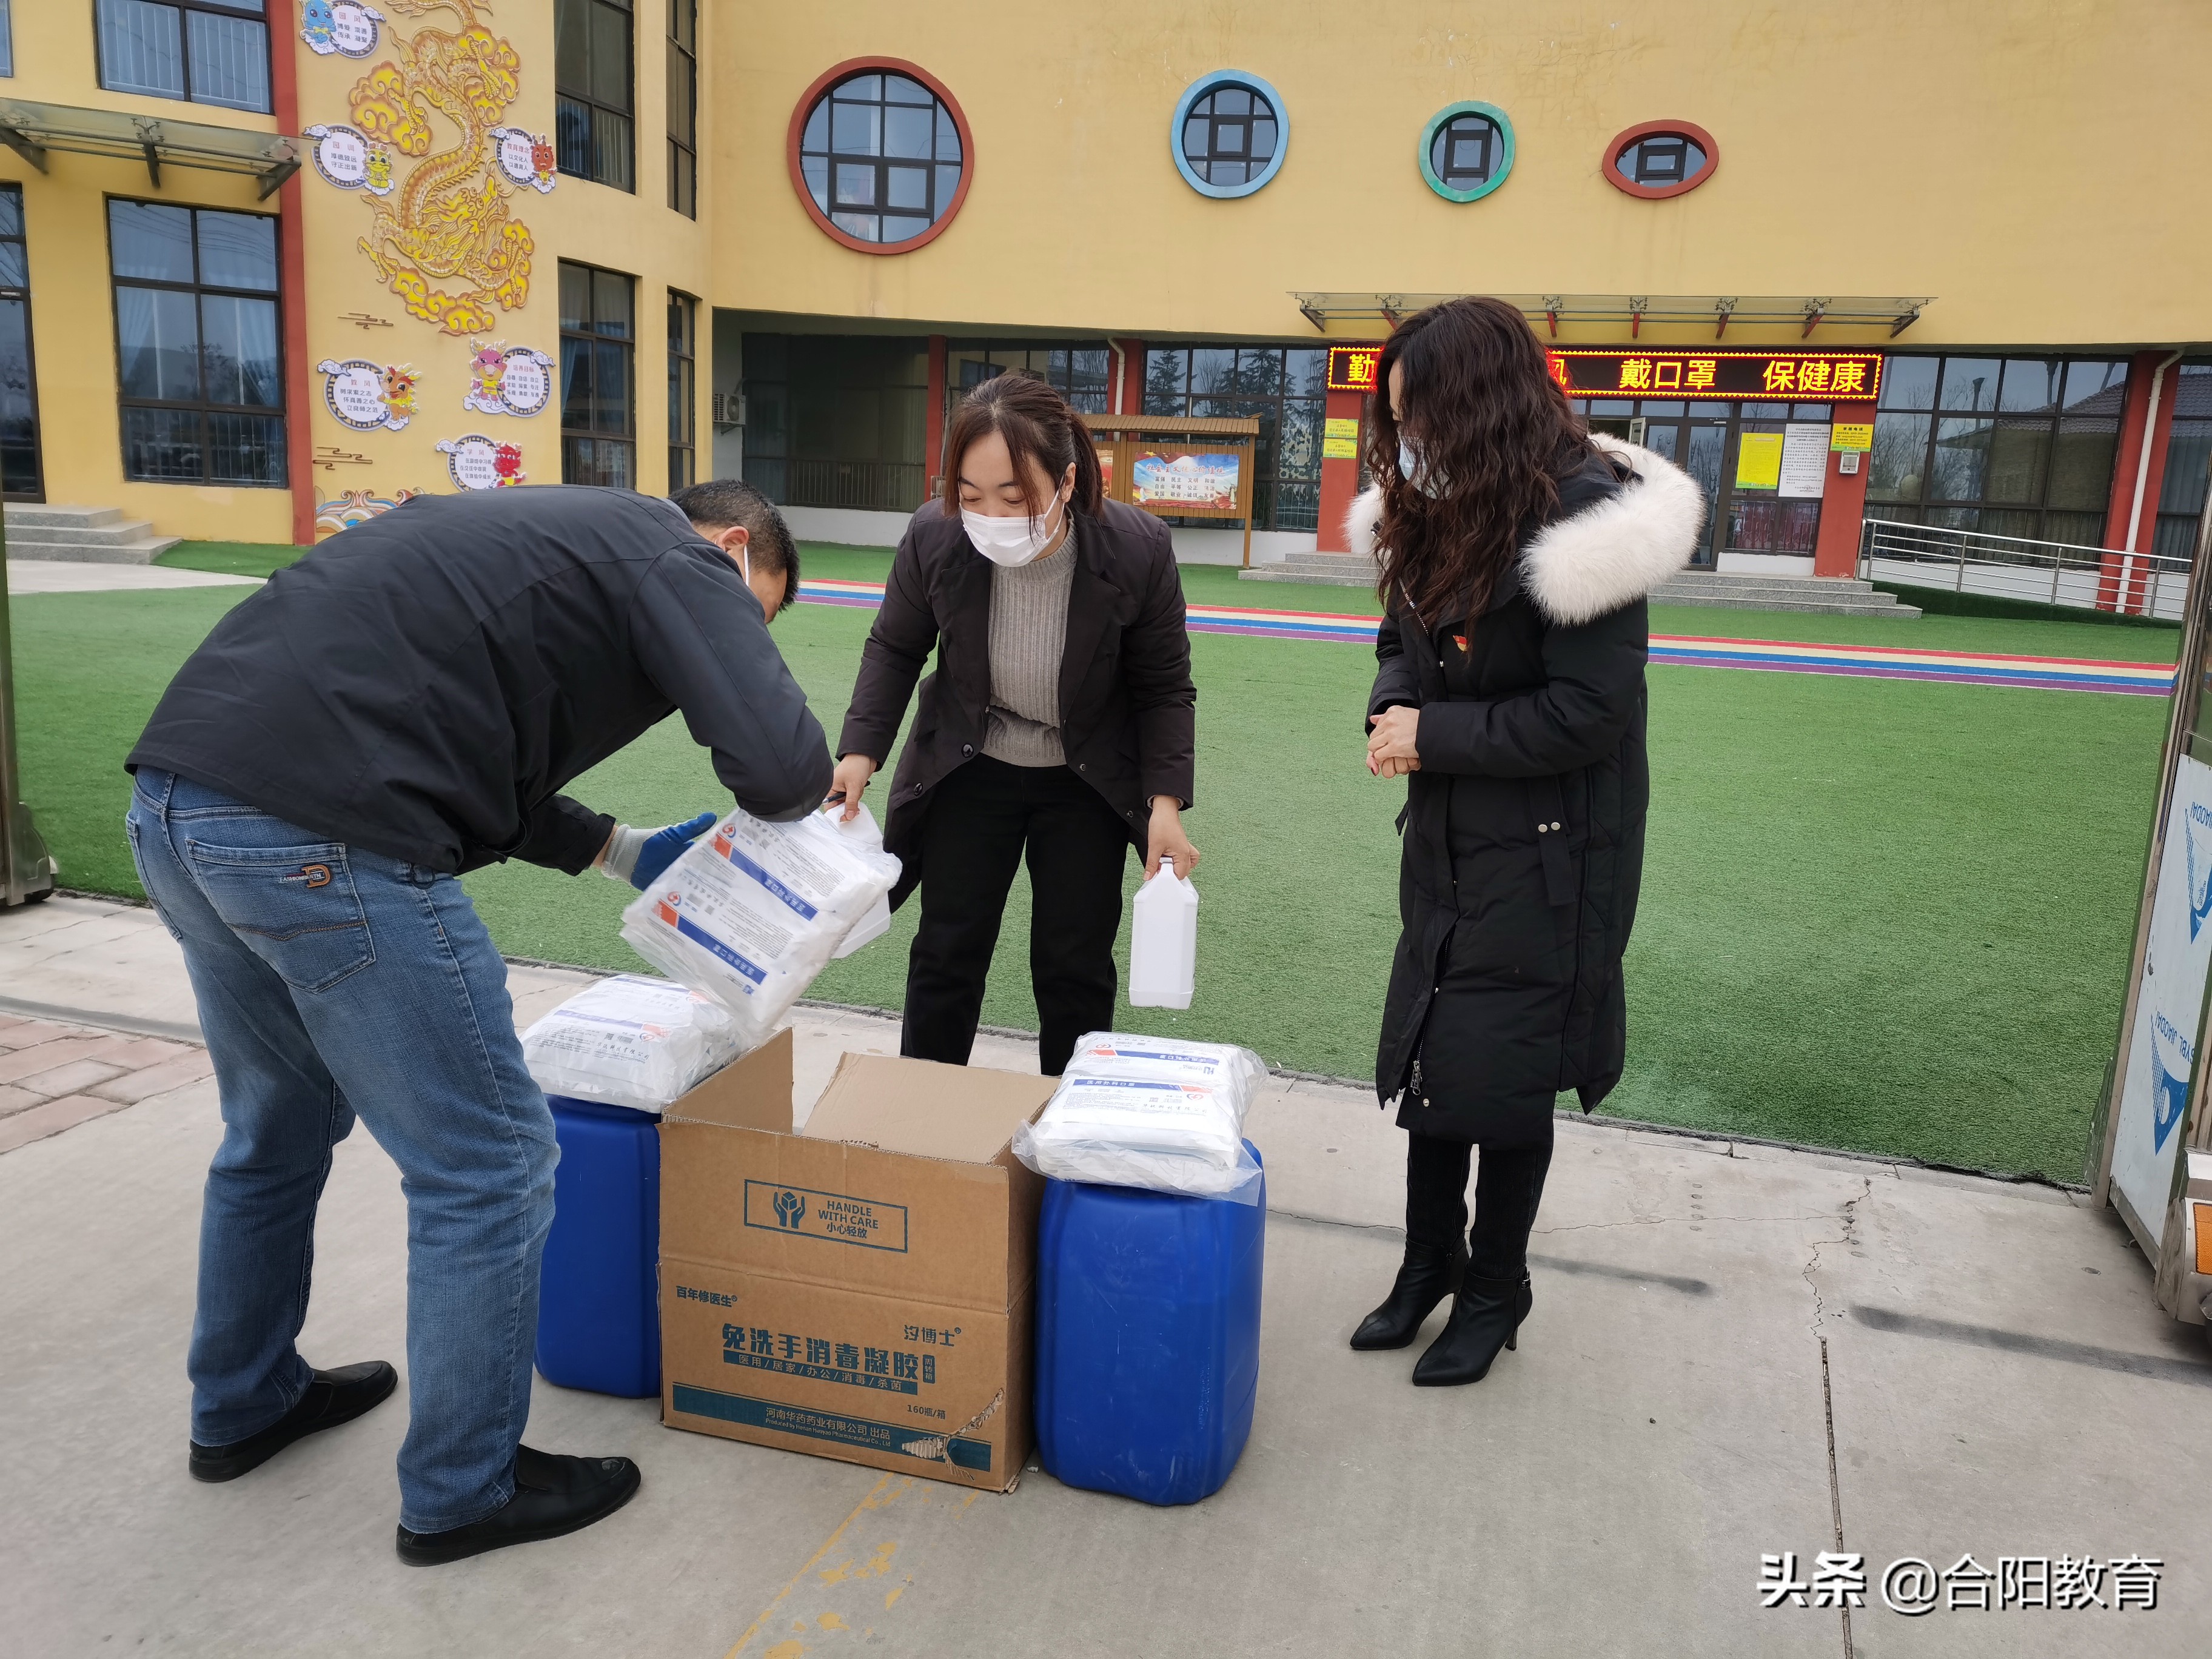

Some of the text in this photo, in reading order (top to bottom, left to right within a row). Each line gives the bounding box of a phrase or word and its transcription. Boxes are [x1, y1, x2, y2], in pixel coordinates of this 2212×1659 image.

[508, 143, 529, 153] 教育理念
[331, 153, 357, 163] 厚德致远
[331, 161, 357, 170] 守正出新
[509, 154, 528, 163] 以文化人
[509, 162, 528, 170] 以德育人
[1619, 359, 1716, 389] 戴口罩
[1763, 360, 1866, 392] 保健康
[827, 1200, 872, 1217] HANDLE
[817, 1209, 879, 1230] WITH CARE
[826, 1222, 868, 1239] 小心轻放
[722, 1323, 919, 1380] 免洗手消毒凝胶
[907, 1404, 946, 1420] 160瓶/箱
[765, 1418, 789, 1427] Produced
[796, 1424, 812, 1432] Henan
[766, 1407, 890, 1440] 河南华药药业有限公司 出品
